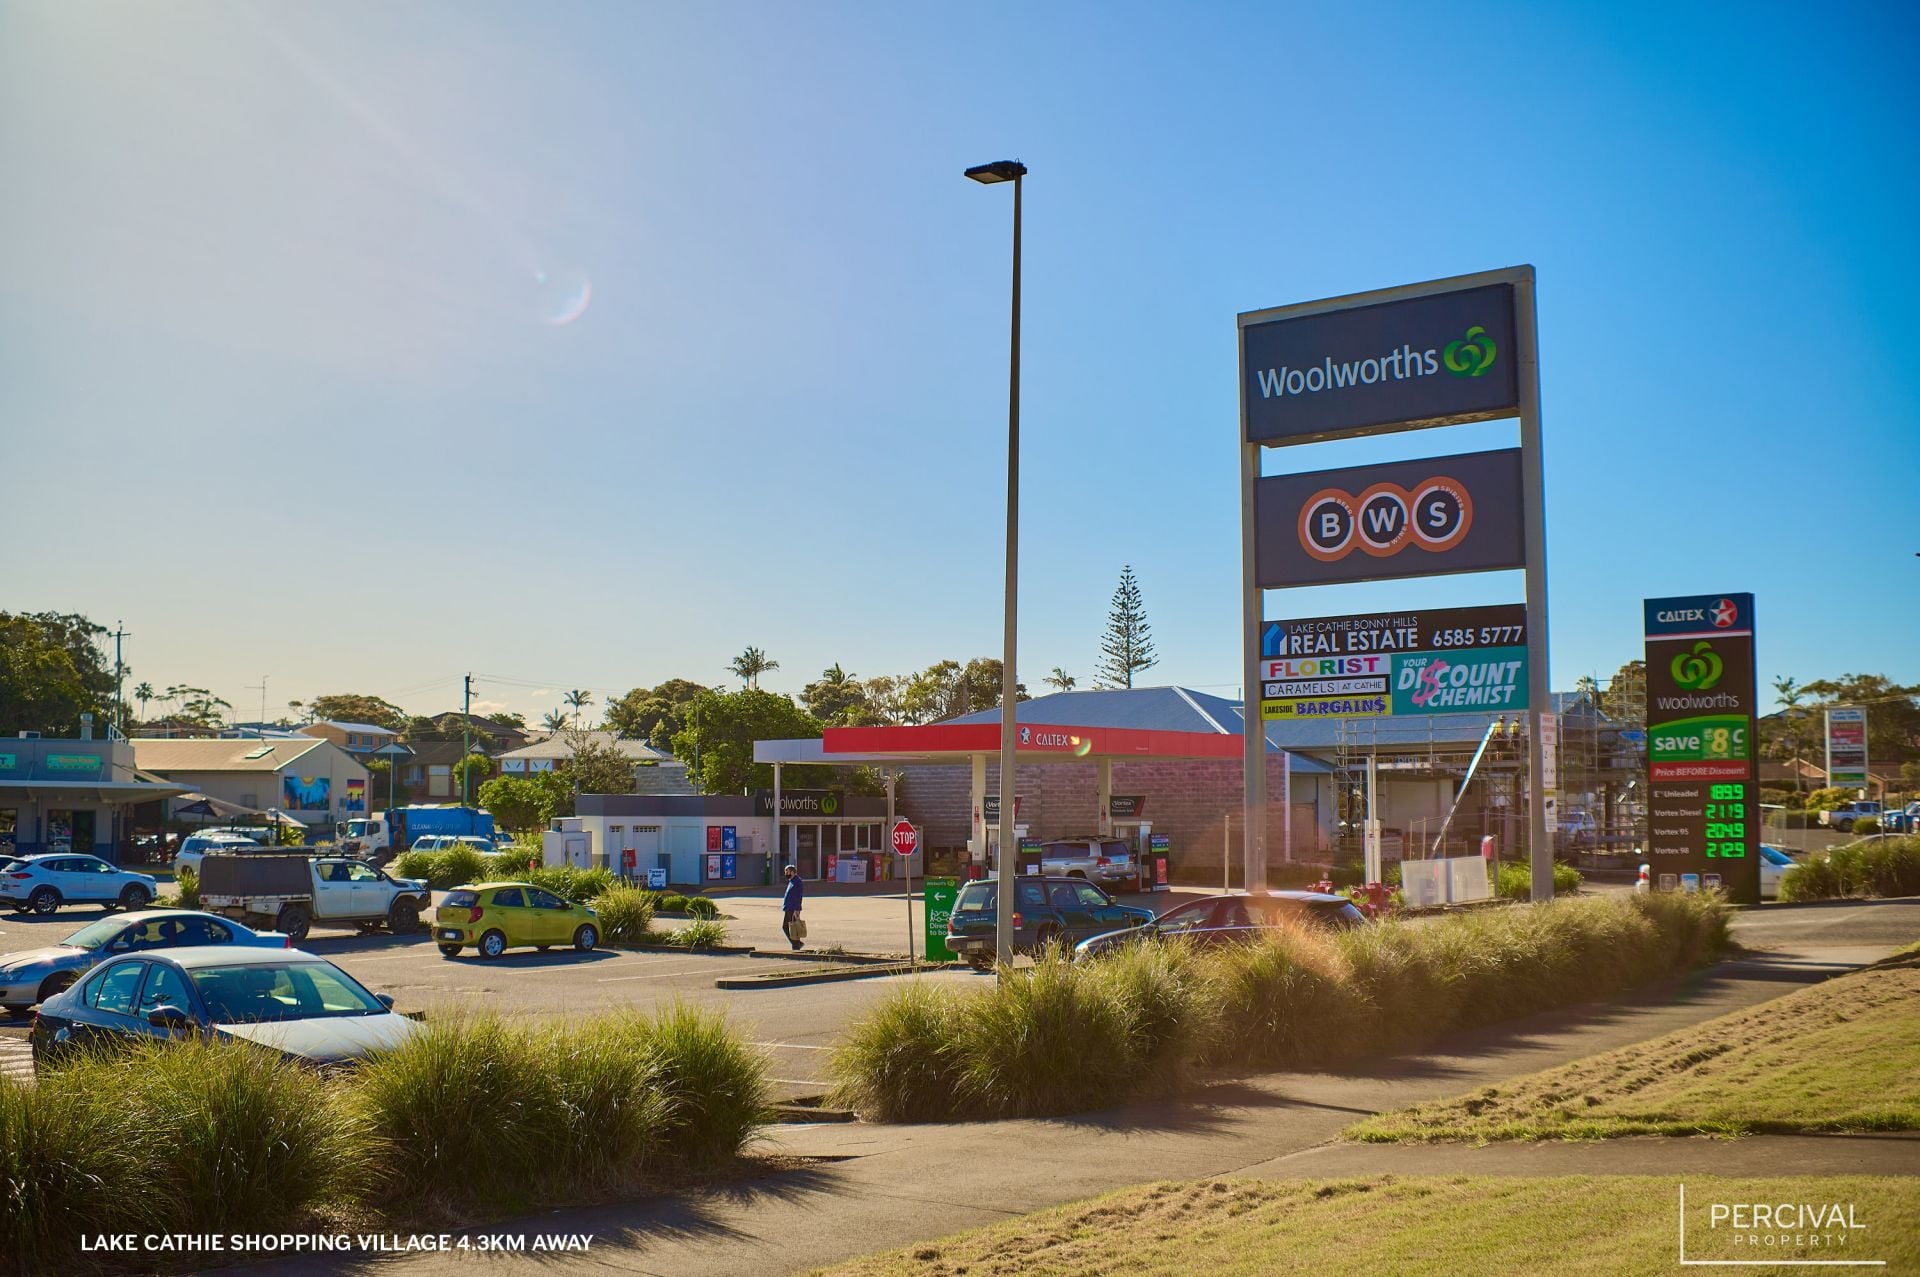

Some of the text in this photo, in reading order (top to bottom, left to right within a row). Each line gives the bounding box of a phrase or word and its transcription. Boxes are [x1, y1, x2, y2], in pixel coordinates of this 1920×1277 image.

[1257, 344, 1439, 399] Woolworths
[1439, 485, 1464, 509] SPIRITS
[1336, 498, 1353, 517] BEER
[1391, 523, 1408, 545] WINE
[1657, 608, 1705, 622] CALTEX
[1290, 616, 1418, 634] LAKE CATHIE BONNY HILLS
[1290, 628, 1418, 655] REAL ESTATE
[1432, 625, 1523, 647] 6585 5777
[1269, 656, 1381, 678] FLORIST
[1403, 657, 1428, 667] YOUR
[1268, 681, 1382, 696] CARAMELS AT CATHIE
[1428, 685, 1517, 707] CHEMIST
[1657, 692, 1740, 710] woolworths
[1264, 705, 1294, 714] LAKESIDE
[1035, 733, 1068, 746] CALTEX
[1655, 736, 1700, 751] save
[1711, 727, 1729, 753] 8
[1655, 767, 1745, 777] Price BEFORE Discount
[1664, 790, 1699, 798] Unleaded
[764, 795, 818, 810] Wolworths
[1654, 809, 1679, 817] Vortex
[1680, 808, 1702, 816] Diesel
[893, 831, 915, 845] STOP
[1654, 828, 1679, 836] Vortex
[1654, 847, 1679, 855] Vortex
